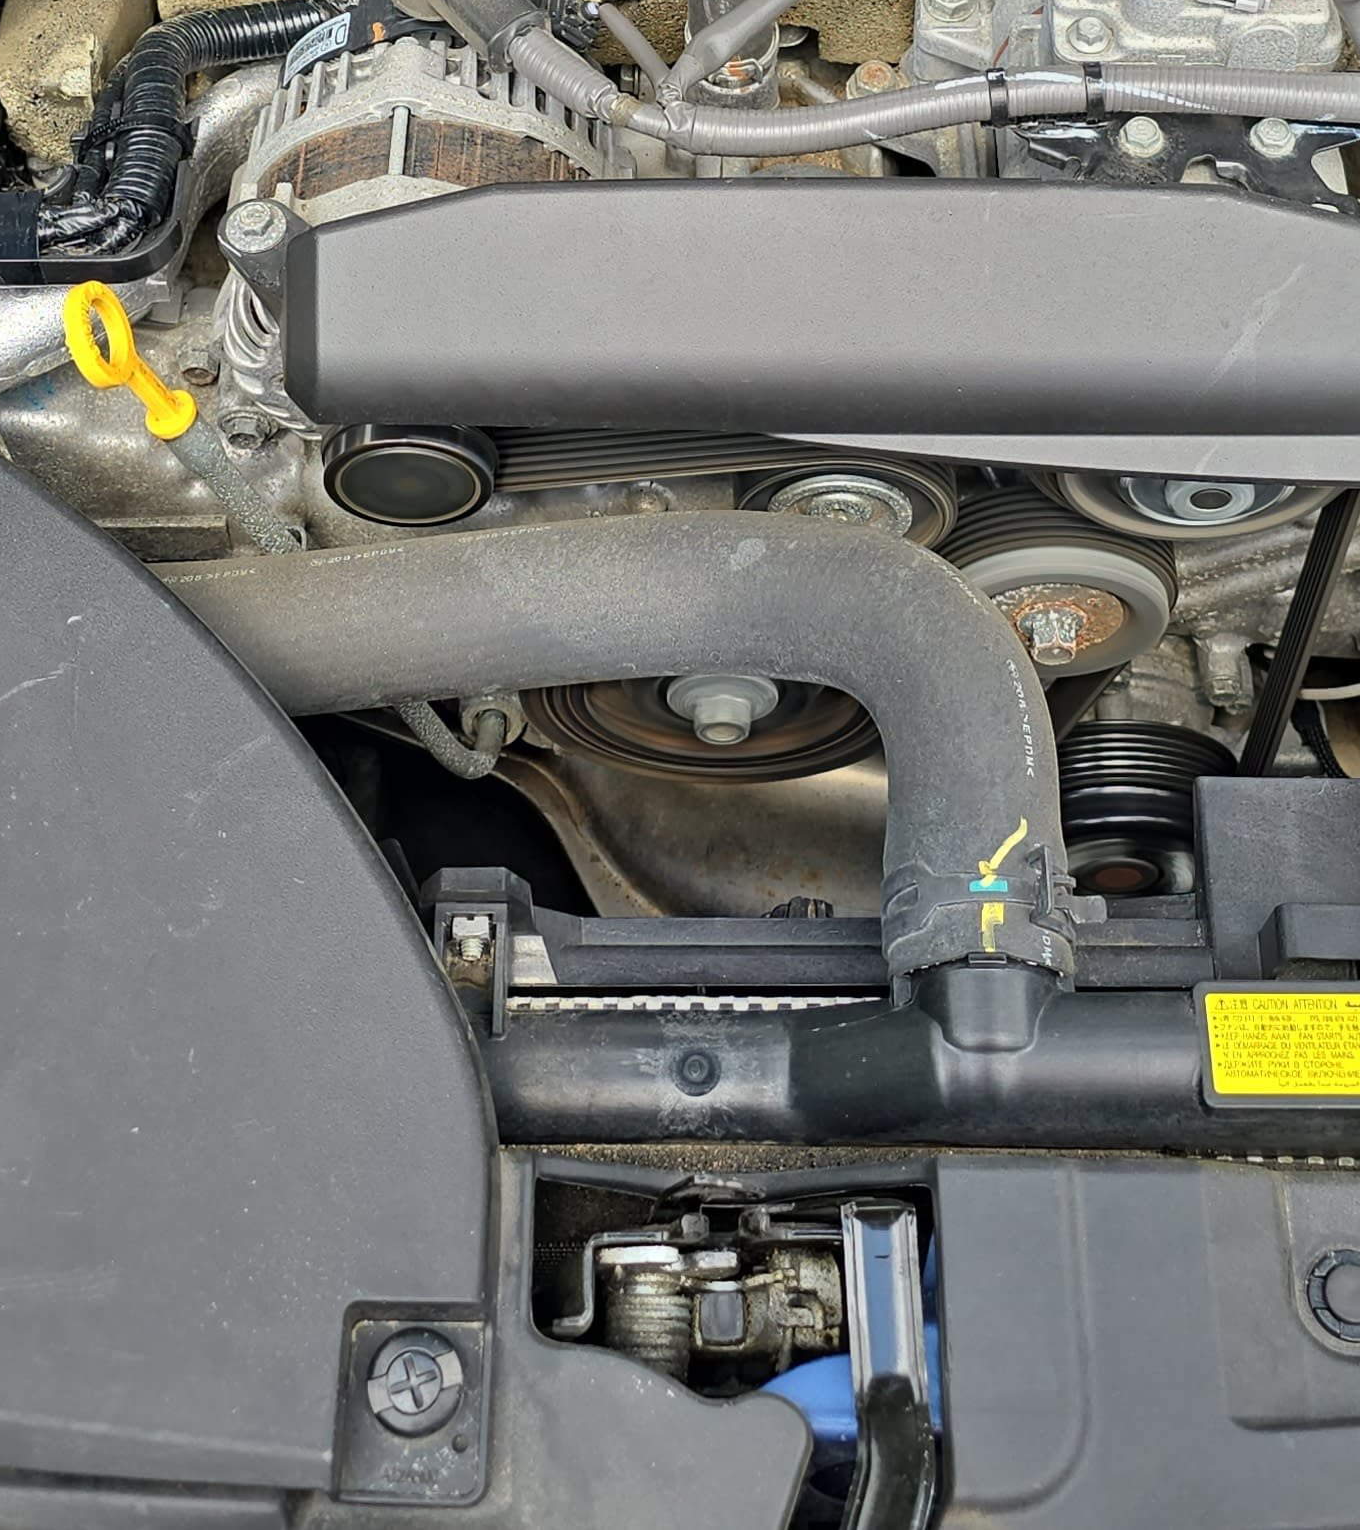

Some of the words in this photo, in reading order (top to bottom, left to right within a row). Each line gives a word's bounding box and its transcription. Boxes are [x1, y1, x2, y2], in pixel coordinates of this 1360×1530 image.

[1252, 998, 1289, 1010] CAUTION
[1293, 998, 1338, 1010] ATTENTION
[1242, 1032, 1268, 1040] HANDS
[1298, 1032, 1313, 1040] FAN
[1316, 1032, 1343, 1040] STARTS
[1281, 1042, 1291, 1050] DU
[1294, 1042, 1341, 1050] VENTILATEUR
[1246, 1051, 1290, 1059] APPROCHEZ
[1294, 1051, 1308, 1059] PAS
[1312, 1051, 1326, 1059] LES
